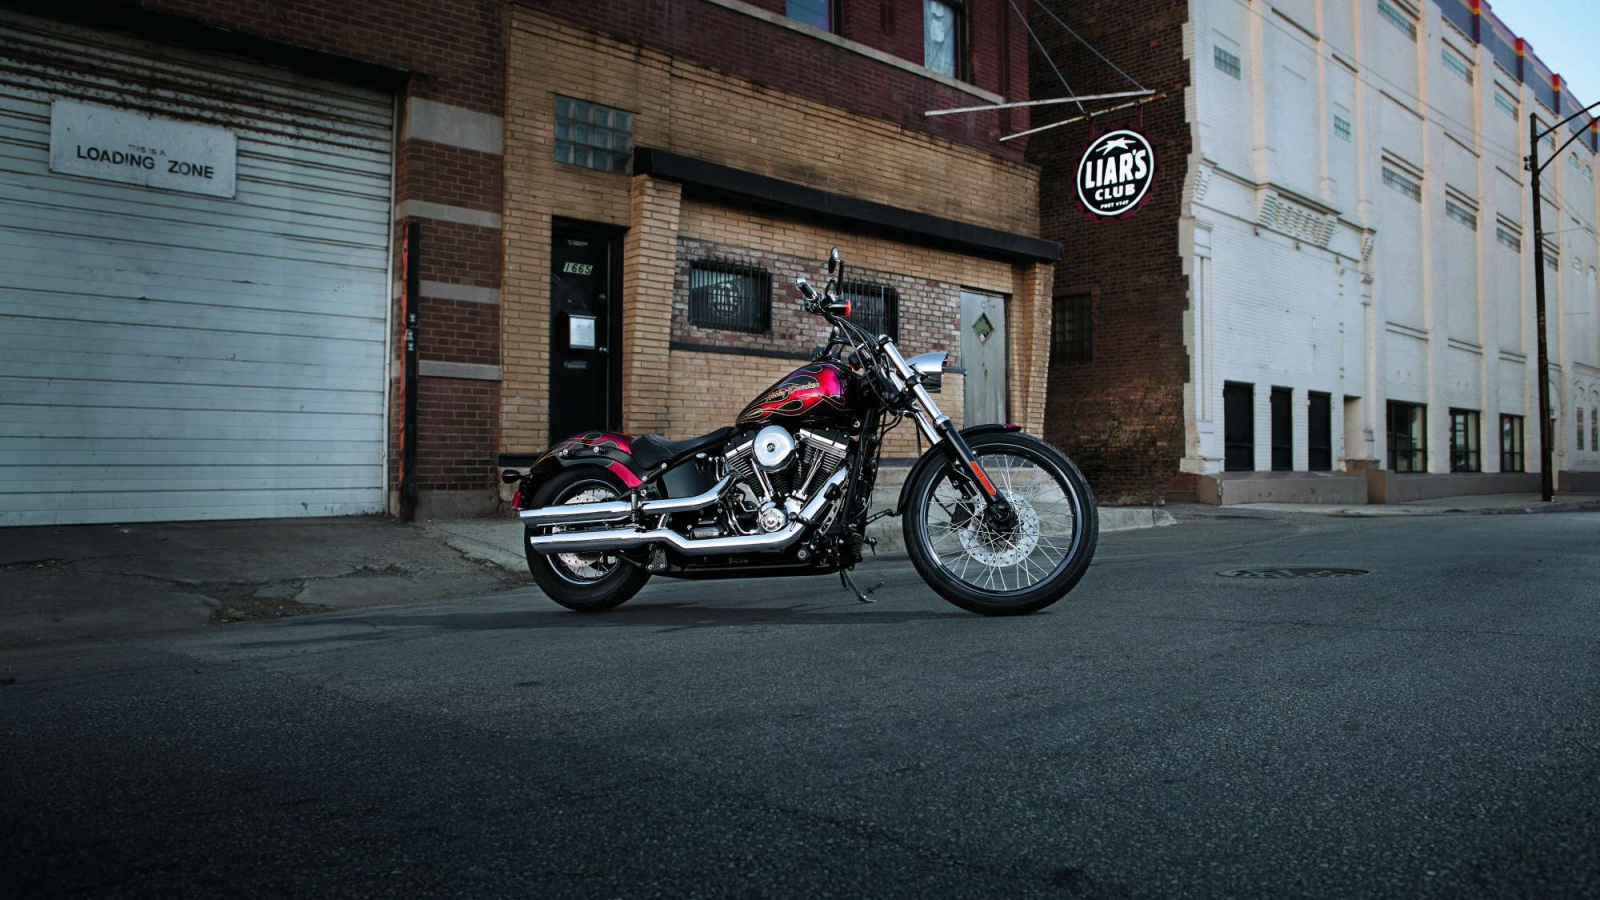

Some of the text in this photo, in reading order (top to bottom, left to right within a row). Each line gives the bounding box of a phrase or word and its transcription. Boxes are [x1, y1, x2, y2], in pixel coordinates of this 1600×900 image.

[115, 116, 223, 154] PARKG
[77, 145, 155, 170] LOADING
[168, 160, 214, 179] ZONE
[128, 144, 146, 154] TIS
[1085, 149, 1147, 189] LIAR'S
[1095, 183, 1135, 201] CLUB
[566, 263, 590, 274] 1665
